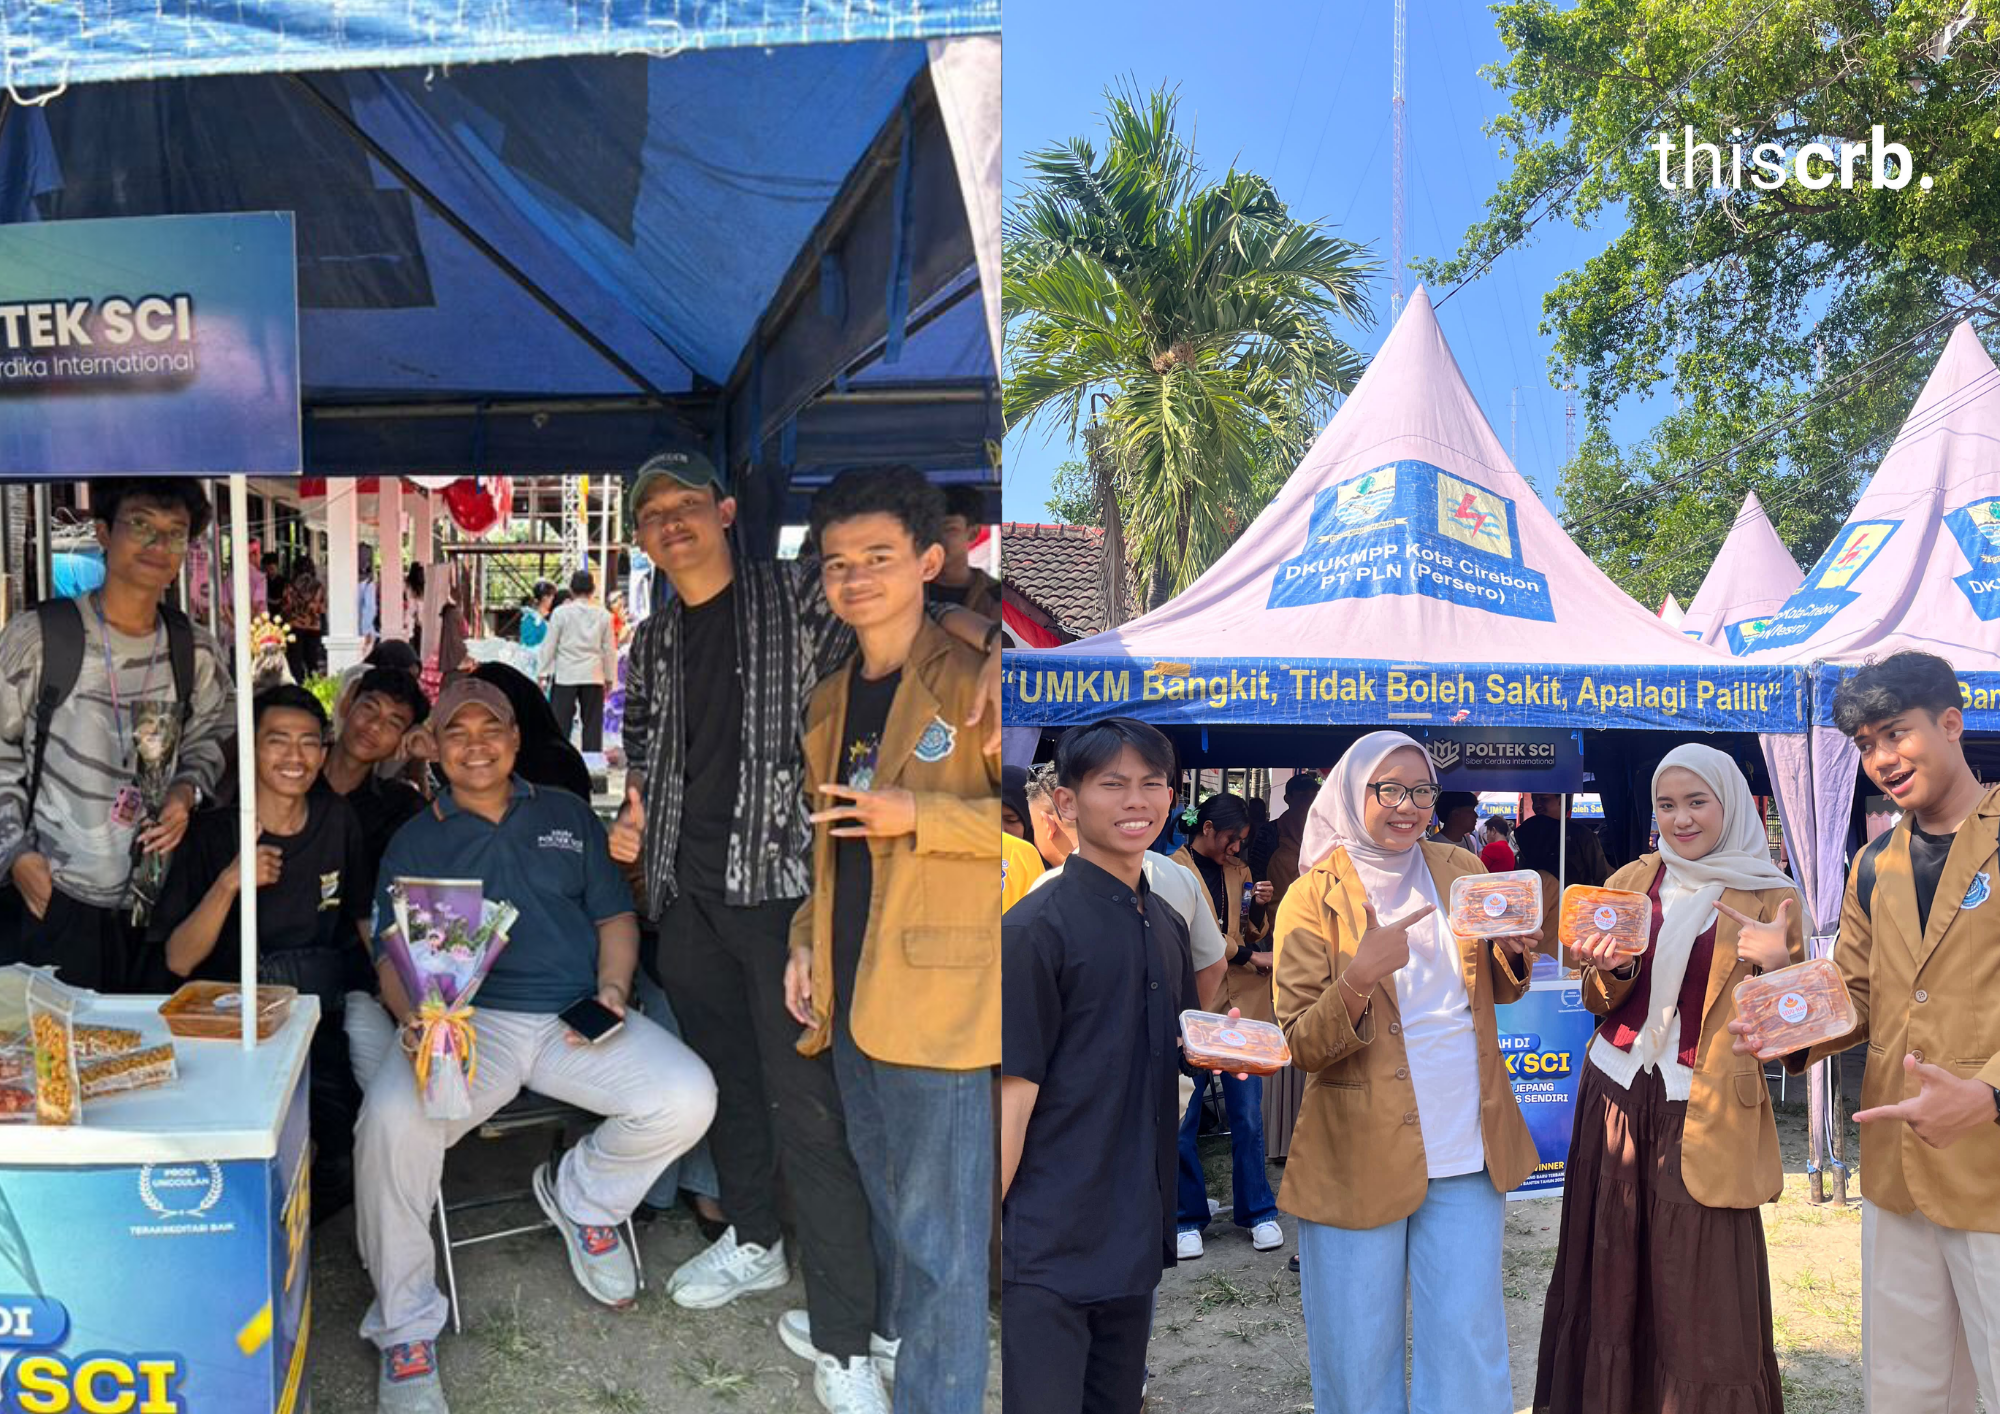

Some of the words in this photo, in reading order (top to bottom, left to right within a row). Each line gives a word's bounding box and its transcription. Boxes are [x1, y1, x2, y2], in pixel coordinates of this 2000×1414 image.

[0, 301, 93, 348] TEK
[101, 297, 191, 344] SCI
[54, 352, 194, 377] International
[1285, 544, 1398, 580] DKUKMPP
[1405, 543, 1453, 568] Kota
[1460, 559, 1540, 593] Cirebon
[1321, 571, 1350, 589] PT
[1356, 563, 1402, 581] PLN
[1410, 562, 1506, 605] (Persero)
[1968, 578, 2000, 593] DK
[1143, 669, 1278, 708] Bangkit,
[1289, 669, 1376, 701] Tidak
[1387, 671, 1475, 704] Boleh
[1486, 673, 1568, 711] Sakit,
[1577, 676, 1686, 716] Apalagi
[1466, 743, 1525, 757] POLTEK
[1529, 743, 1555, 757] SCI
[1572, 805, 1589, 813] oleh
[1515, 1037, 1530, 1048] DI
[1524, 1052, 1570, 1074] SCI
[1515, 1082, 1554, 1093] JEPANG
[1524, 1093, 1569, 1103] SENDIRI
[17, 1356, 177, 1414] SCI
